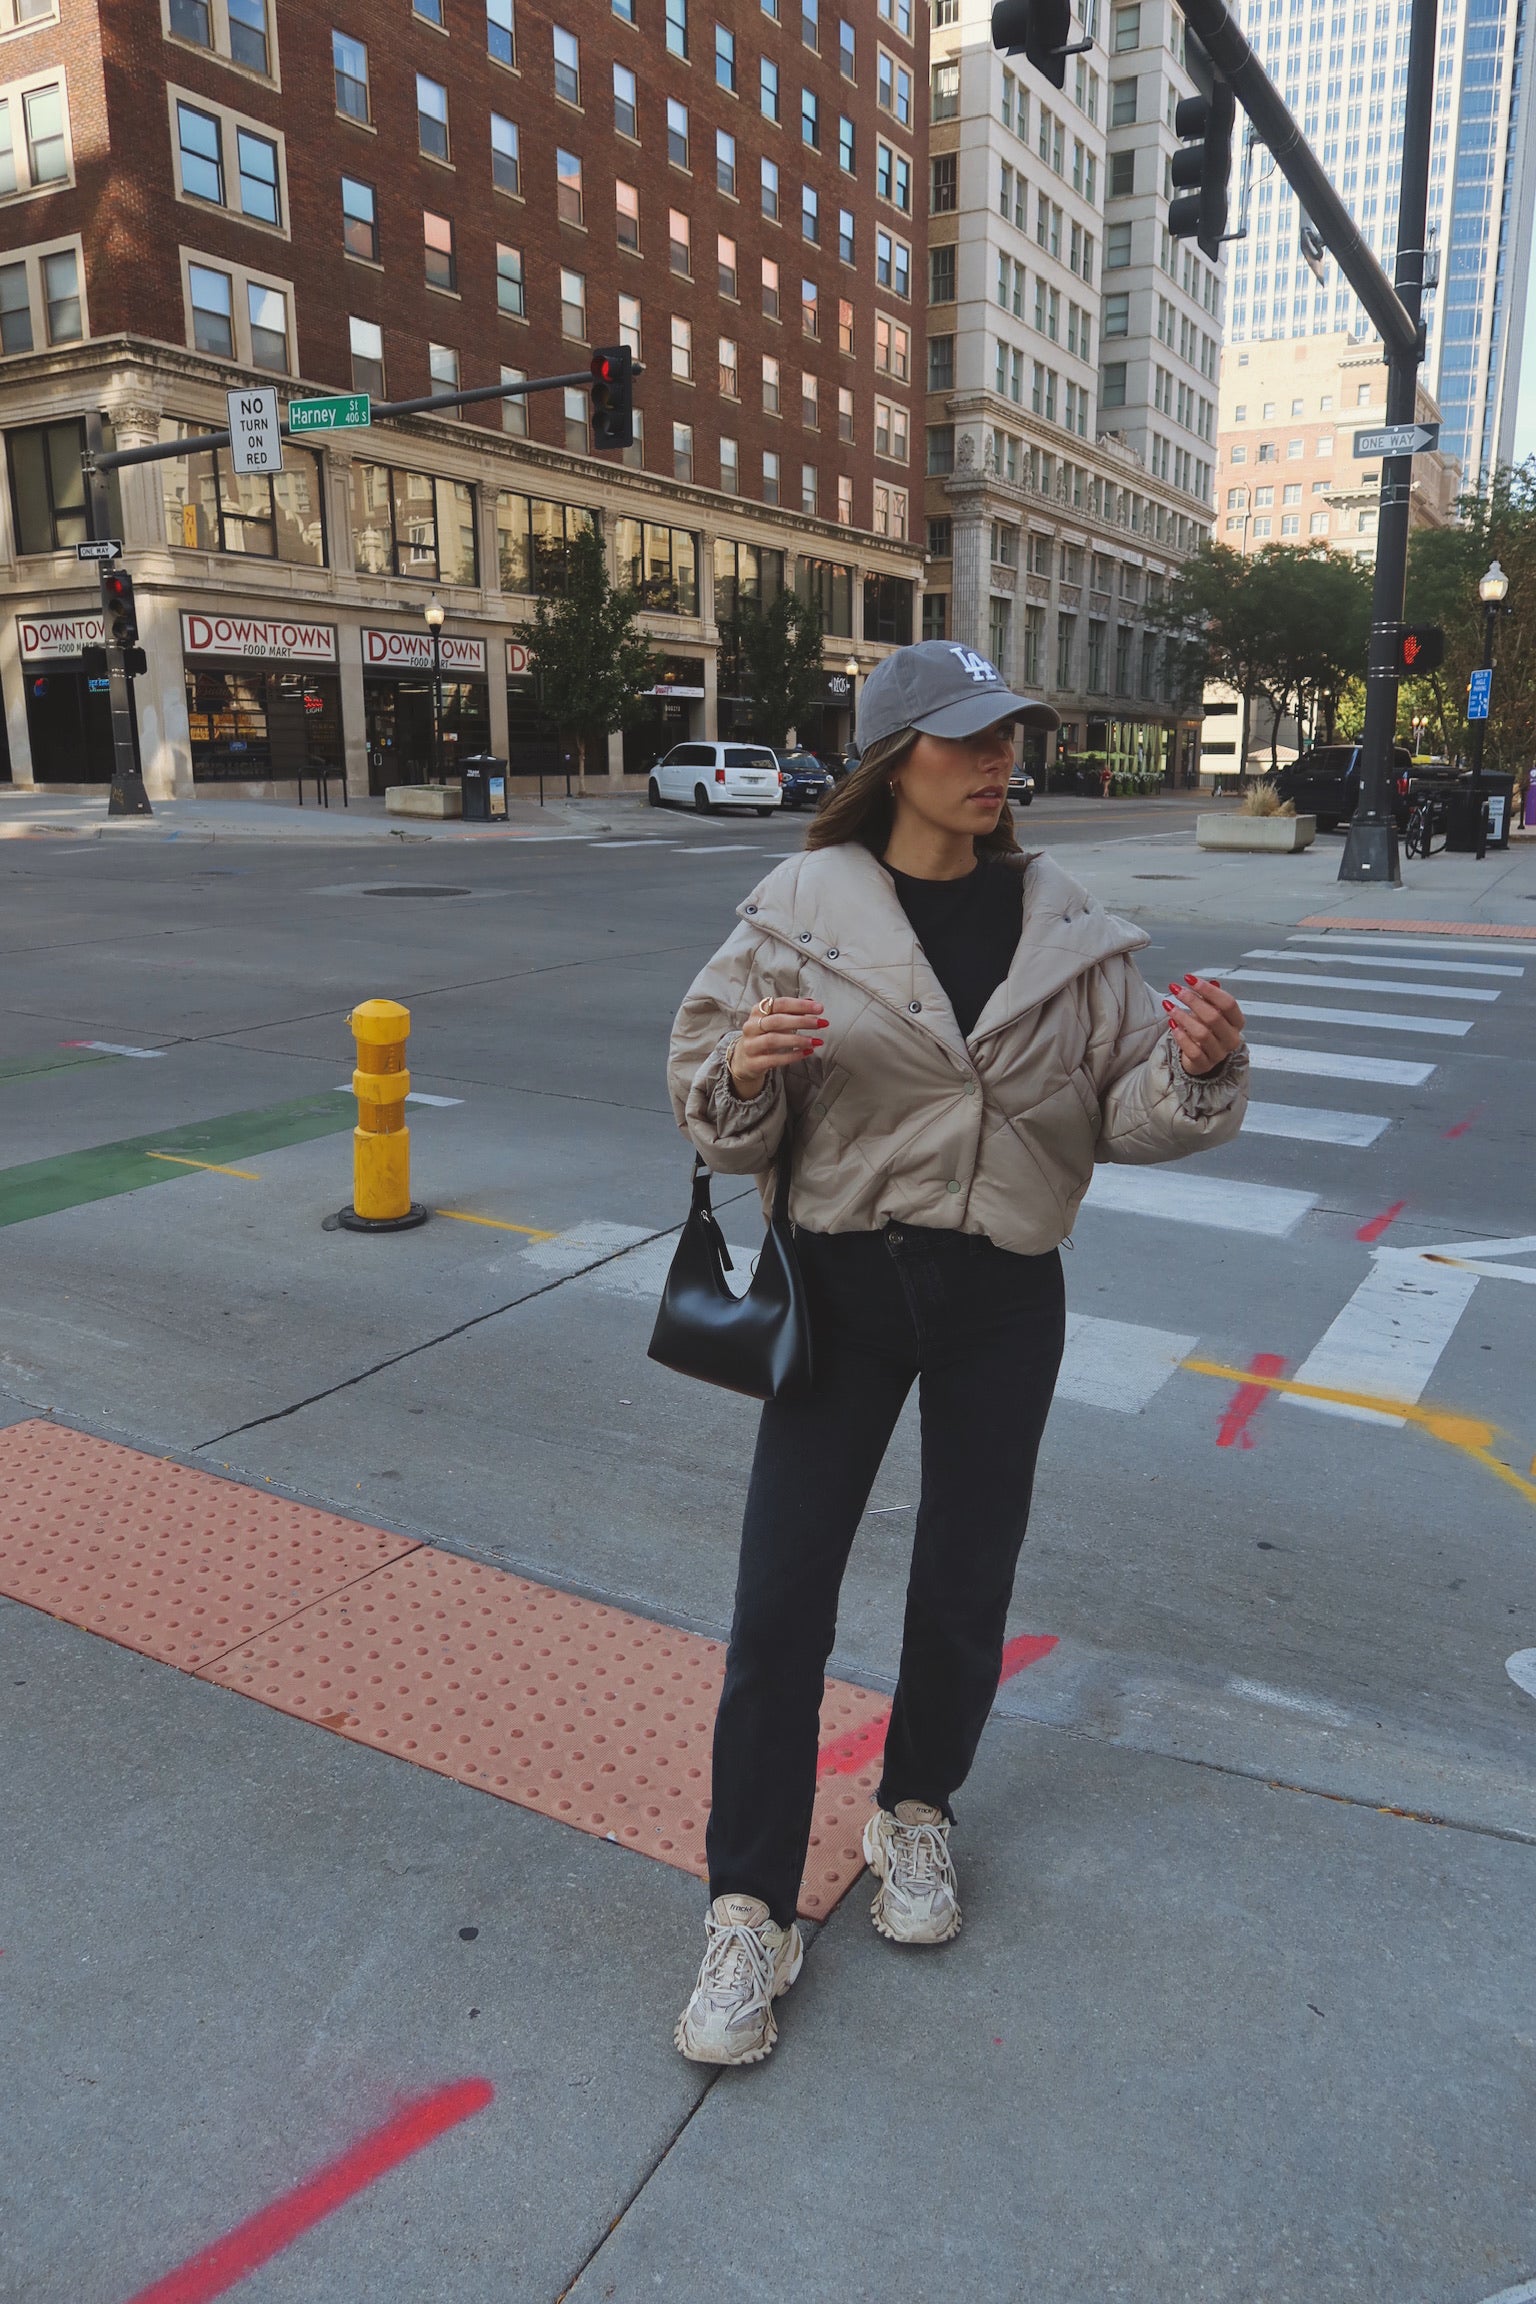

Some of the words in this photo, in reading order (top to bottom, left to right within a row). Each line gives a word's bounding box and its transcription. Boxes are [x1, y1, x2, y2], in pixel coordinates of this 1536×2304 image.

[241, 398, 263, 415] NO
[349, 400, 359, 411] St
[292, 407, 337, 427] Harney
[361, 411, 367, 422] S
[240, 418, 268, 432] TURN
[248, 436, 263, 448] ON
[1362, 437, 1384, 450] ONE
[1390, 433, 1415, 447] WAY
[246, 452, 267, 465] RED
[81, 547, 94, 556] ONE
[96, 546, 109, 554] WAY
[23, 620, 105, 652] DOWNTO
[188, 616, 331, 649] DOWNTOWN
[58, 643, 75, 653] FOOD
[243, 644, 266, 655] FOOD
[269, 647, 292, 658] MART
[410, 656, 429, 667] FOOD
[949, 646, 998, 682] LA
